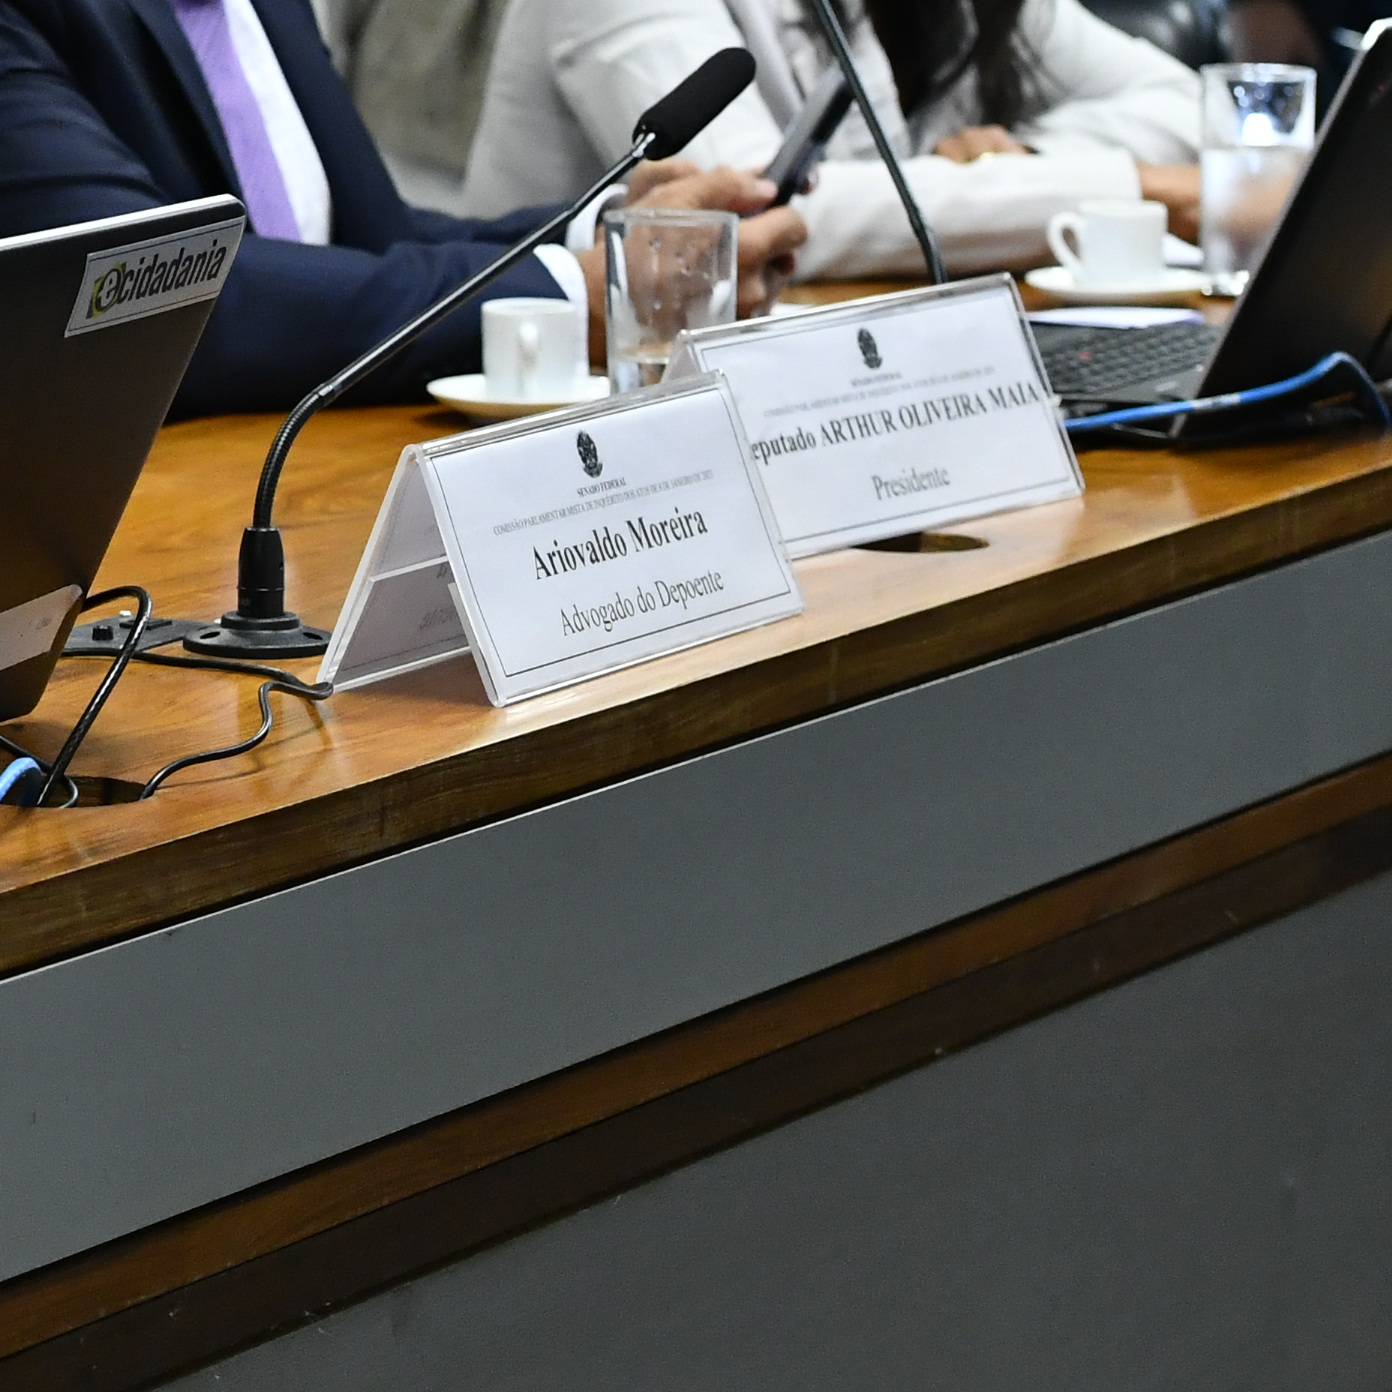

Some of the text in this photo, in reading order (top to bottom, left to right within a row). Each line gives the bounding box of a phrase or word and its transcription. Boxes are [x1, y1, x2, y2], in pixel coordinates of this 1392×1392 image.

[751, 426, 816, 465] eputado
[819, 409, 897, 447] ARTHUR
[898, 393, 987, 429] OLIVEIRA
[988, 382, 1038, 410] MAIA
[871, 467, 950, 500] Presidente
[533, 506, 708, 580] Ariovaldo Moreira
[560, 570, 724, 636] Advogado do Depoente
